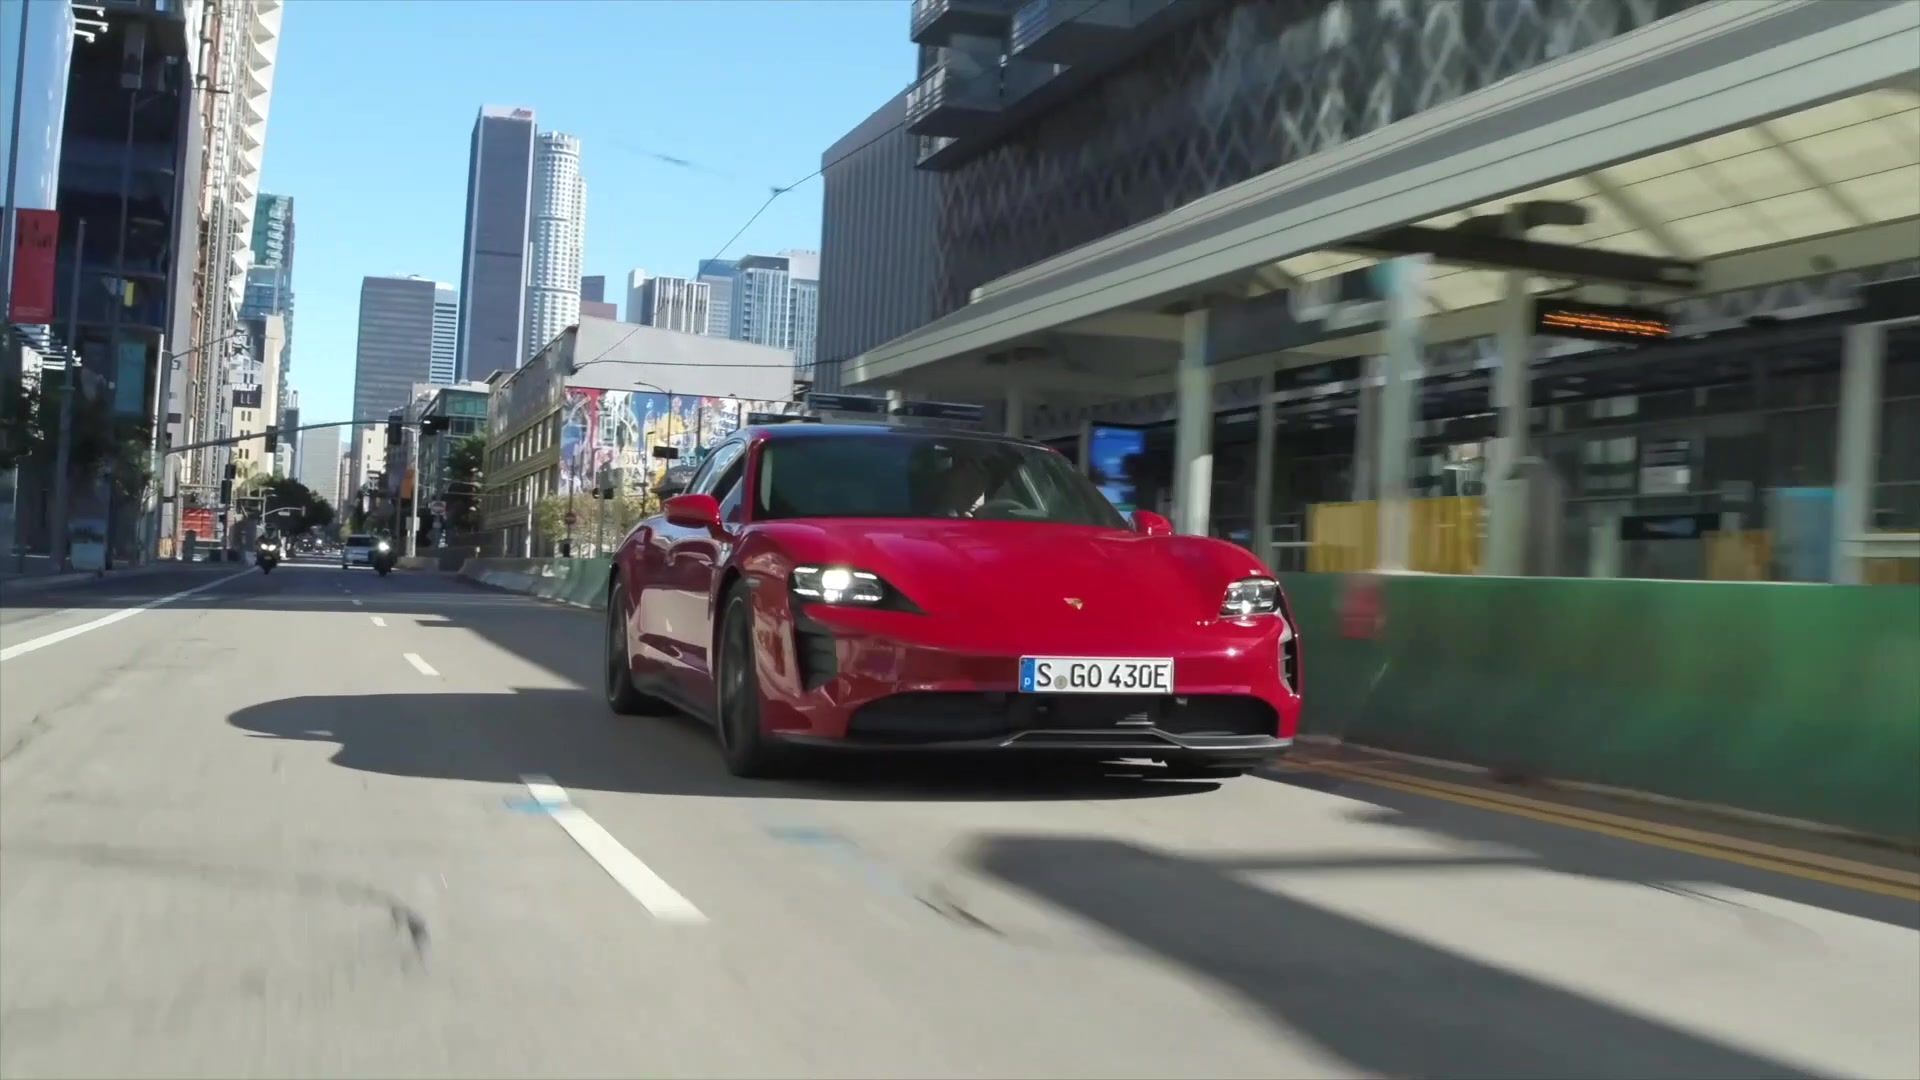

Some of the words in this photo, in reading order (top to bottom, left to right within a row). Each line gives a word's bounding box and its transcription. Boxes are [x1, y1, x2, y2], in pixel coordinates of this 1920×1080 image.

[1036, 662, 1052, 687] S
[1070, 663, 1102, 688] GO
[1108, 664, 1169, 689] 430E
